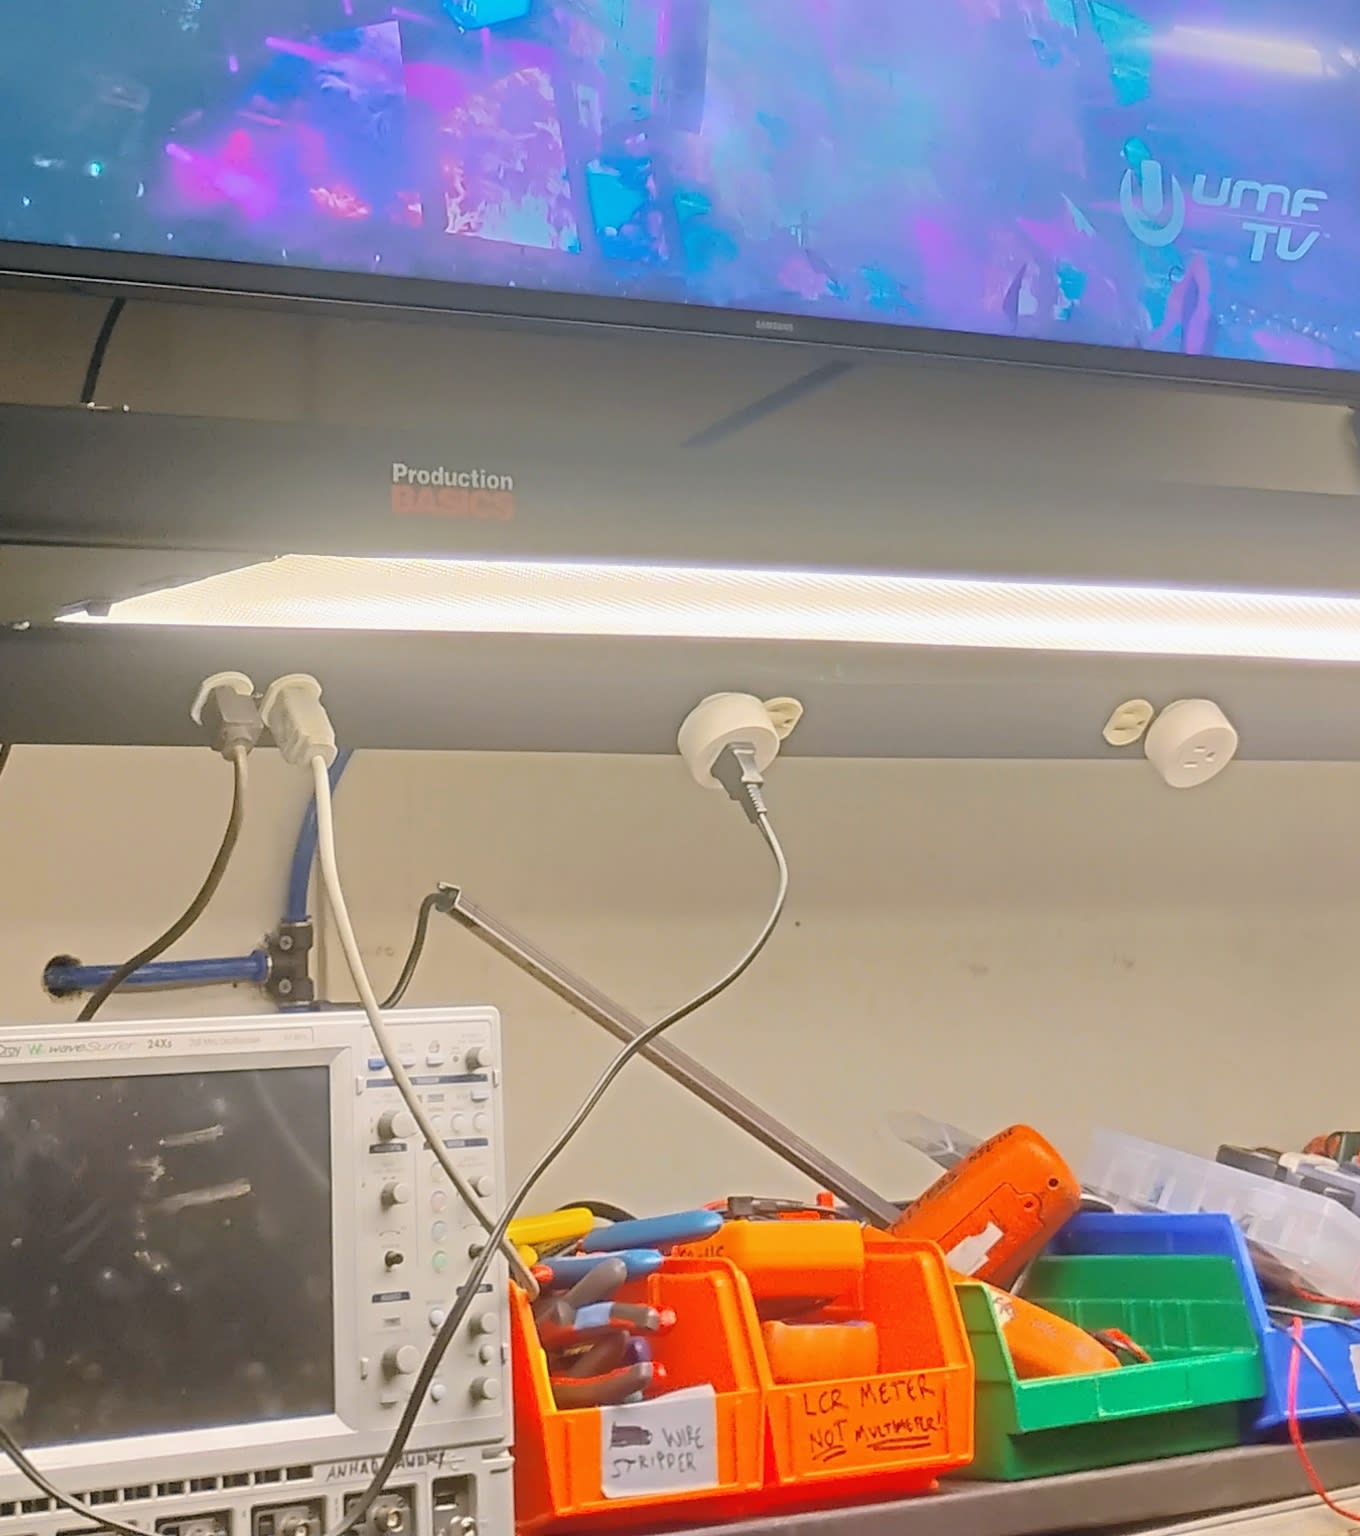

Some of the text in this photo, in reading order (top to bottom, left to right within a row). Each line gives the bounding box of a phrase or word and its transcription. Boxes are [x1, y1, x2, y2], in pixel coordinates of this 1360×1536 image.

[1241, 220, 1321, 262] TV
[392, 463, 513, 491] Production
[146, 1038, 173, 1050] 24Xs
[802, 1373, 937, 1416] LCR METER
[661, 1424, 705, 1450] WIRE
[809, 1418, 849, 1453] NOT
[610, 1450, 697, 1478] STRIPPER
